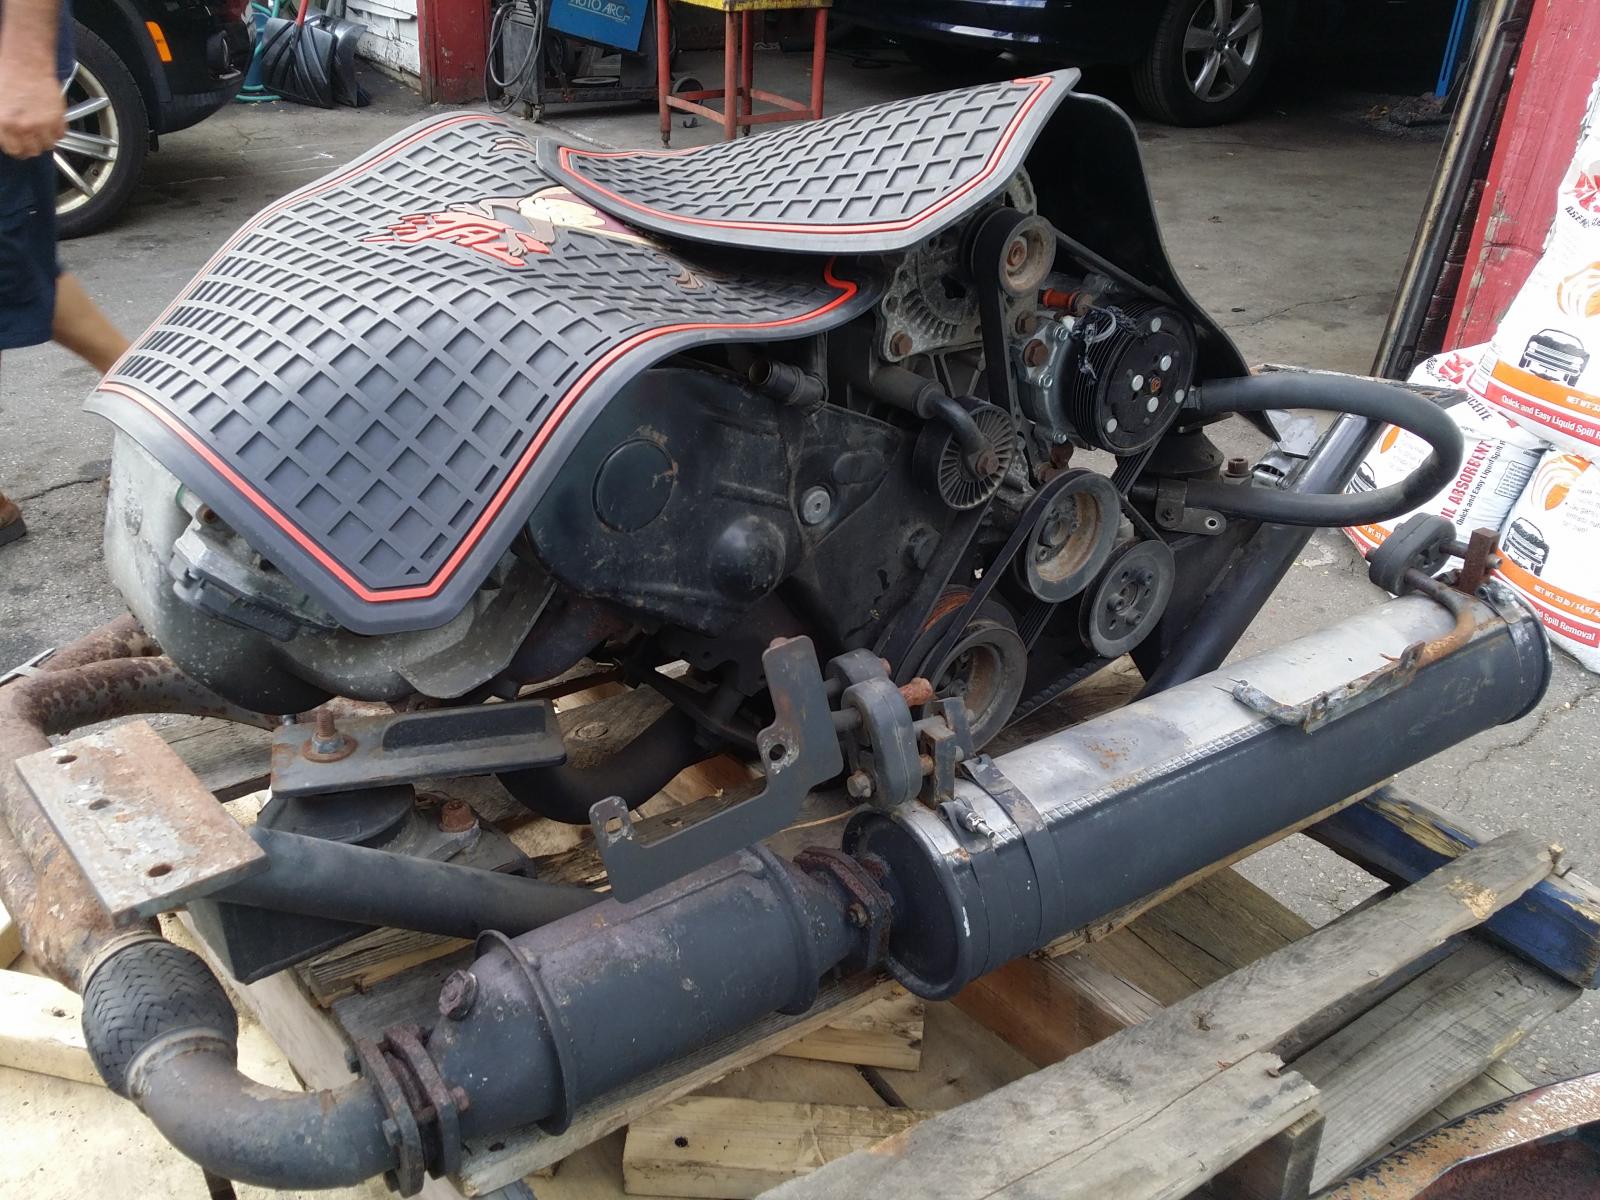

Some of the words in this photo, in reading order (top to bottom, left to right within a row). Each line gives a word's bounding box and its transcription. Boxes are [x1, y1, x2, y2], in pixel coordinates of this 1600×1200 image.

[1503, 395, 1519, 408] Quick
[1521, 405, 1534, 414] and
[1534, 408, 1551, 422] Easy
[1552, 415, 1576, 430] Liquid
[1576, 424, 1595, 438] Spill
[1448, 441, 1493, 504] ABSORBENT
[1456, 508, 1469, 525] Quick
[1466, 495, 1476, 507] and
[1472, 480, 1486, 495] Easy
[1481, 459, 1496, 480] Liquid
[1545, 614, 1559, 627] Spill
[1560, 620, 1596, 640] Removal
